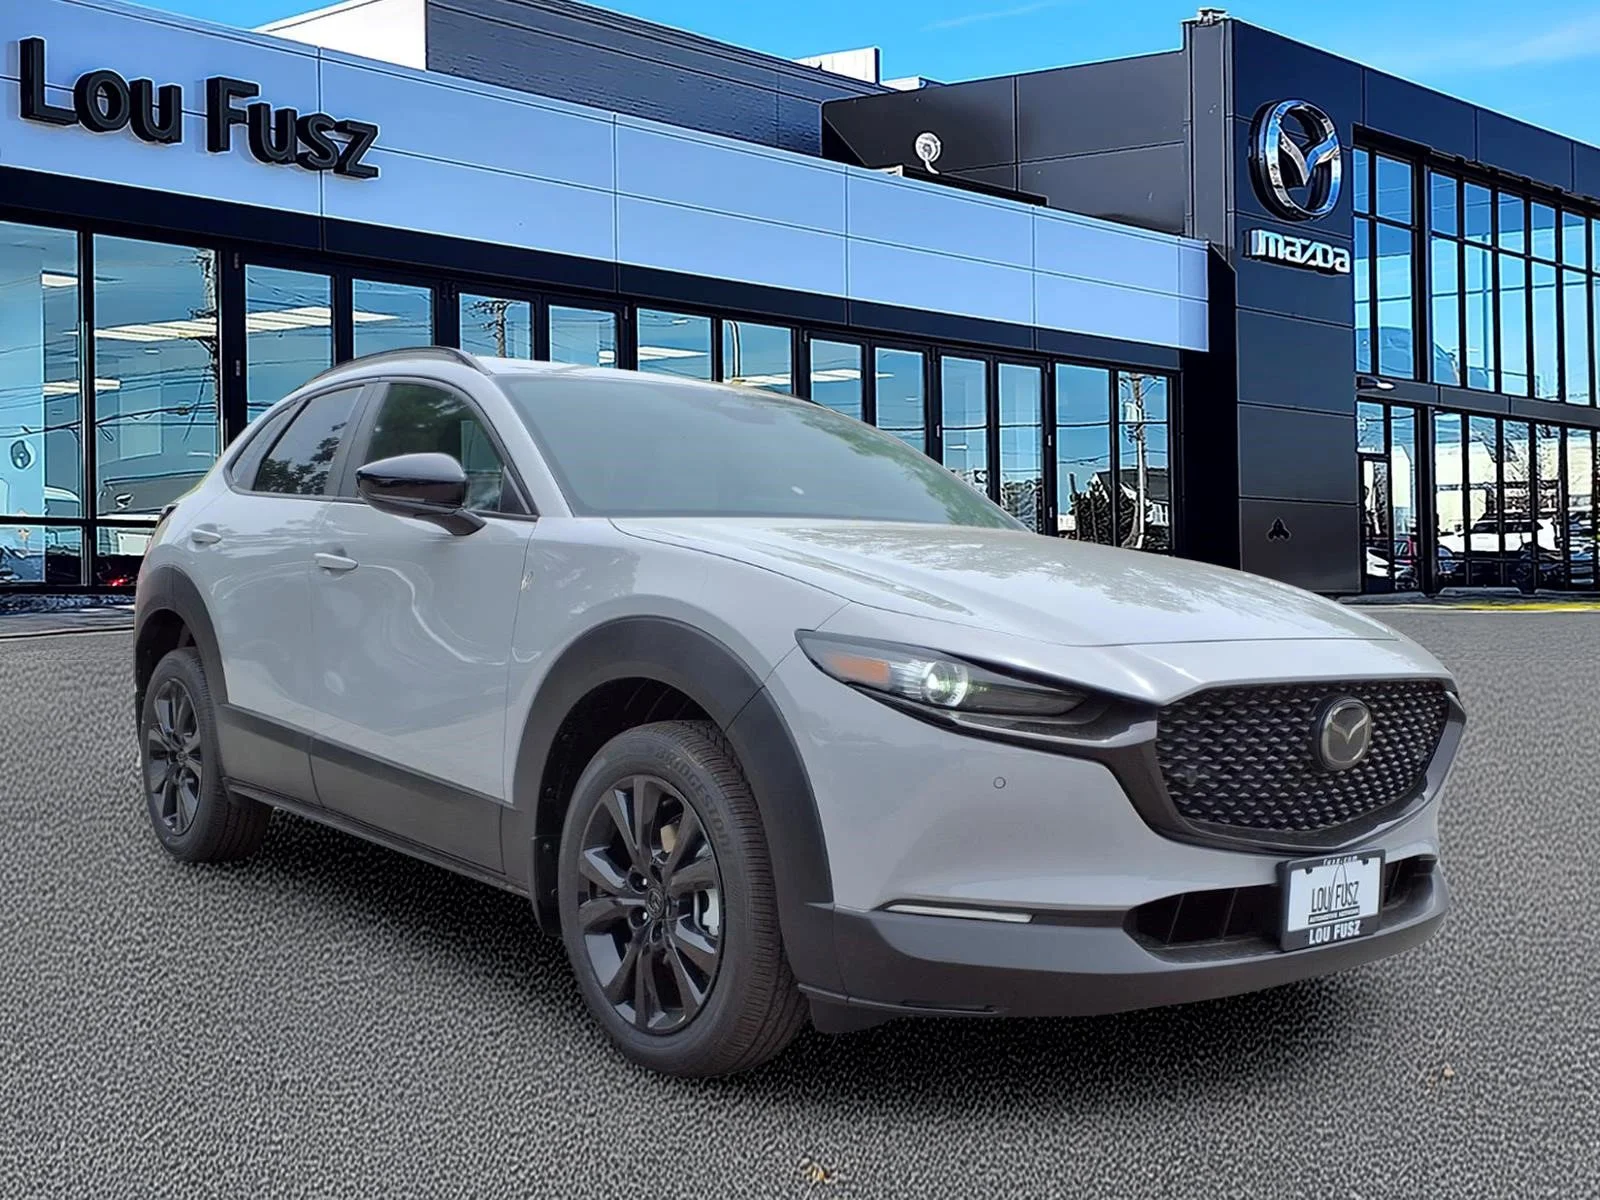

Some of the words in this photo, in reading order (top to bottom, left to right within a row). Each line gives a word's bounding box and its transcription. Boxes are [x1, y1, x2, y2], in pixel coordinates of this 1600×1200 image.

[19, 37, 182, 143] Lou
[206, 76, 380, 179] Fusz
[1249, 229, 1351, 274] mazda
[1311, 886, 1332, 912] LOU
[1335, 881, 1359, 909] FUSZ
[1309, 925, 1330, 945] LOU
[1333, 920, 1361, 940] FUSZ
